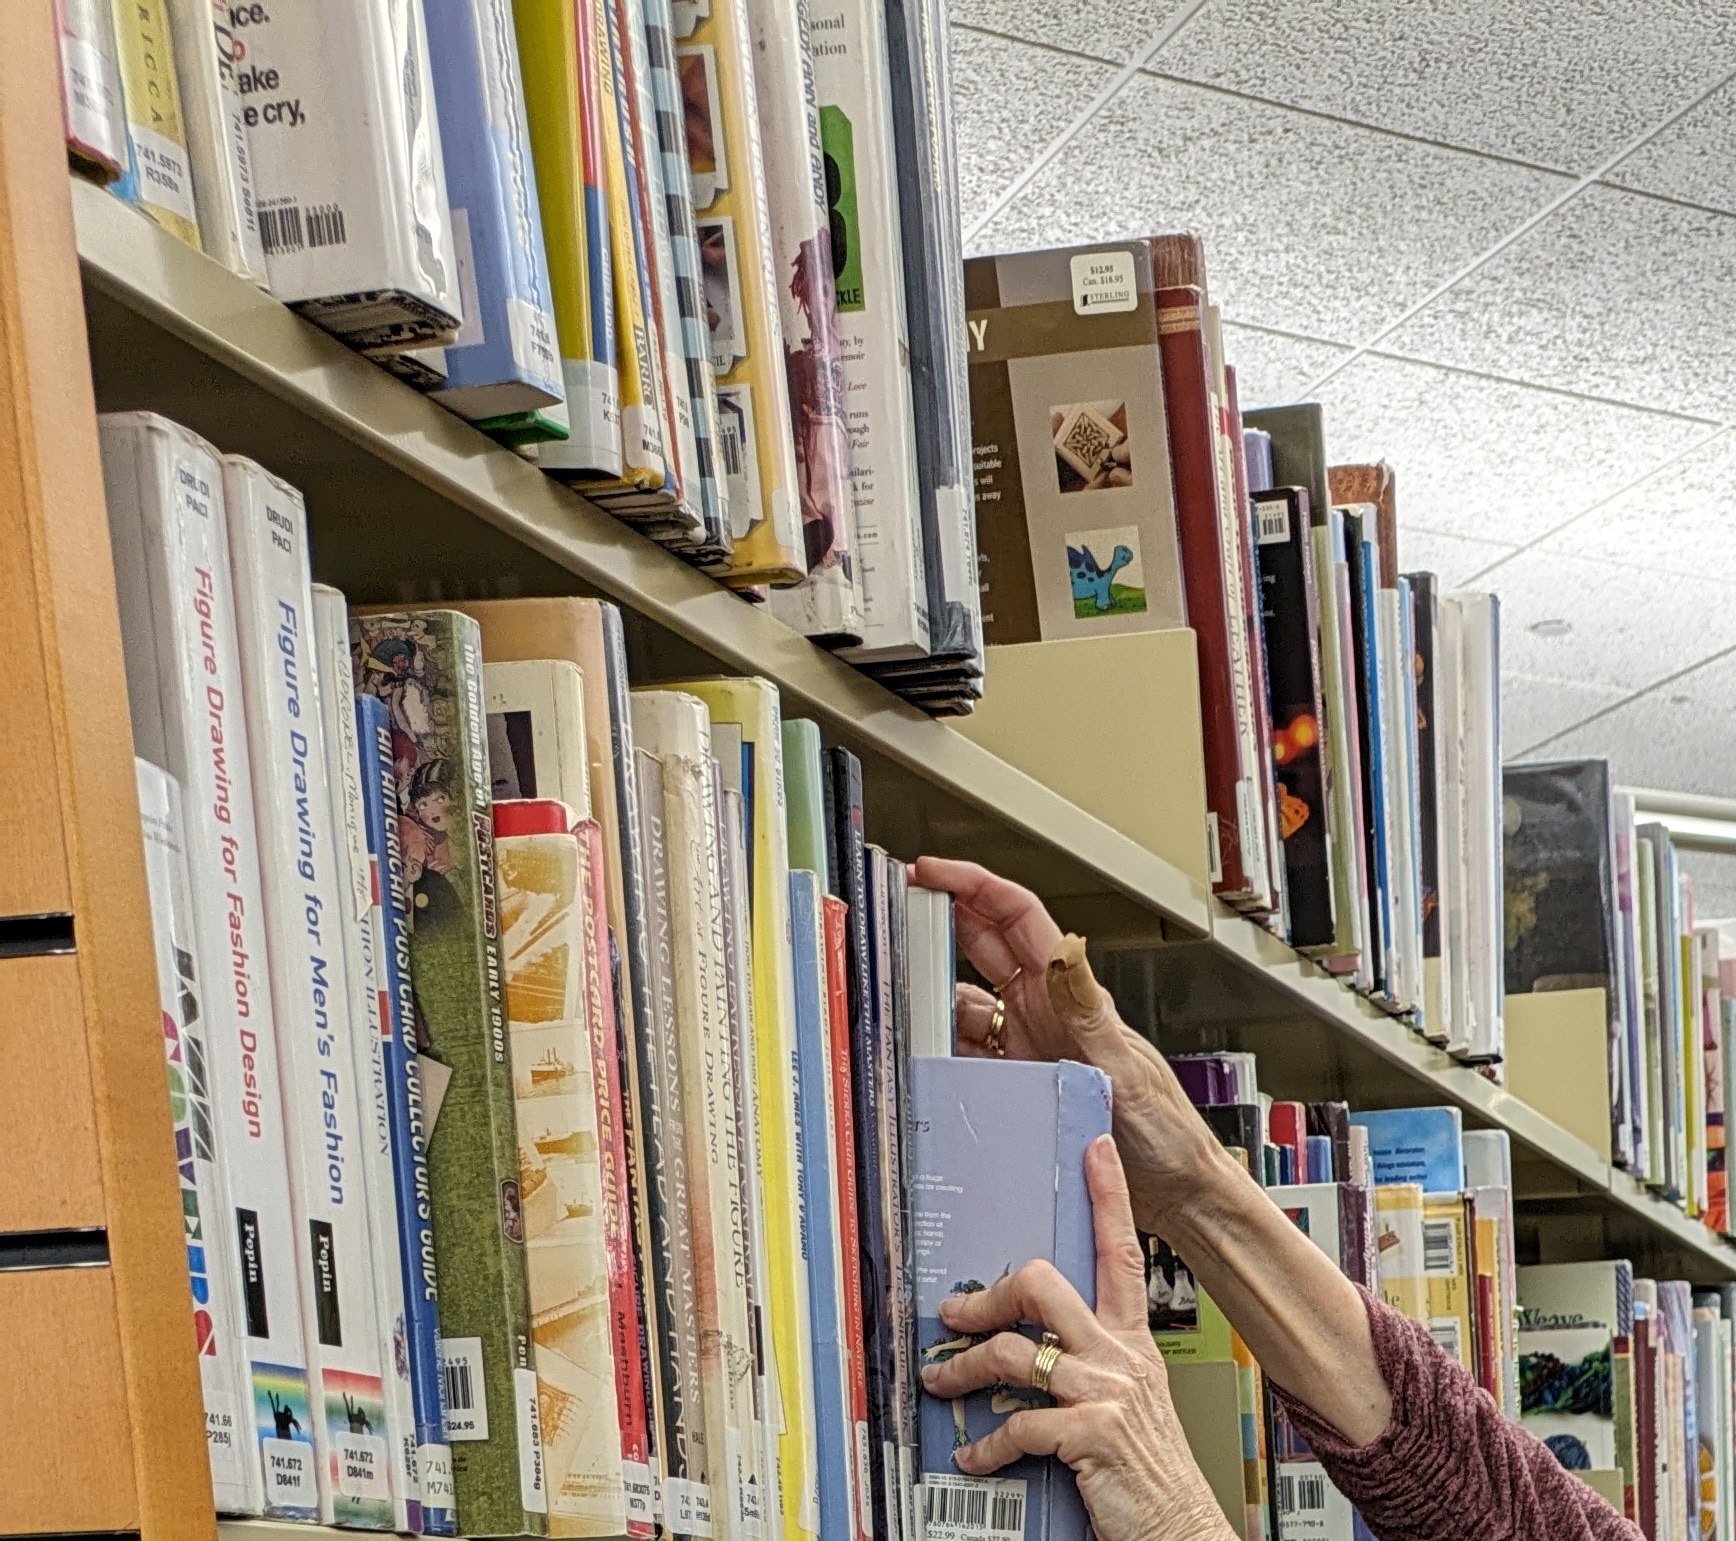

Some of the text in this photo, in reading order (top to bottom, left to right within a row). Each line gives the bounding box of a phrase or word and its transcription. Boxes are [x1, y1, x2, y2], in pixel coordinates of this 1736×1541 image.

[263, 100, 305, 125] cry,
[1082, 275, 1098, 286] Can.
[1090, 265, 1113, 276] $12.95
[1090, 290, 1130, 301] STERLING
[178, 468, 211, 499] DRUDI
[185, 493, 208, 520] PACI
[266, 505, 294, 535] DRUDI
[271, 529, 292, 554] PACI
[194, 565, 262, 1140] Figure Drawing for Fashion Design
[276, 600, 345, 1206] Figure Drawing for Men's Fashion
[927, 1530, 955, 1541] $22.99
